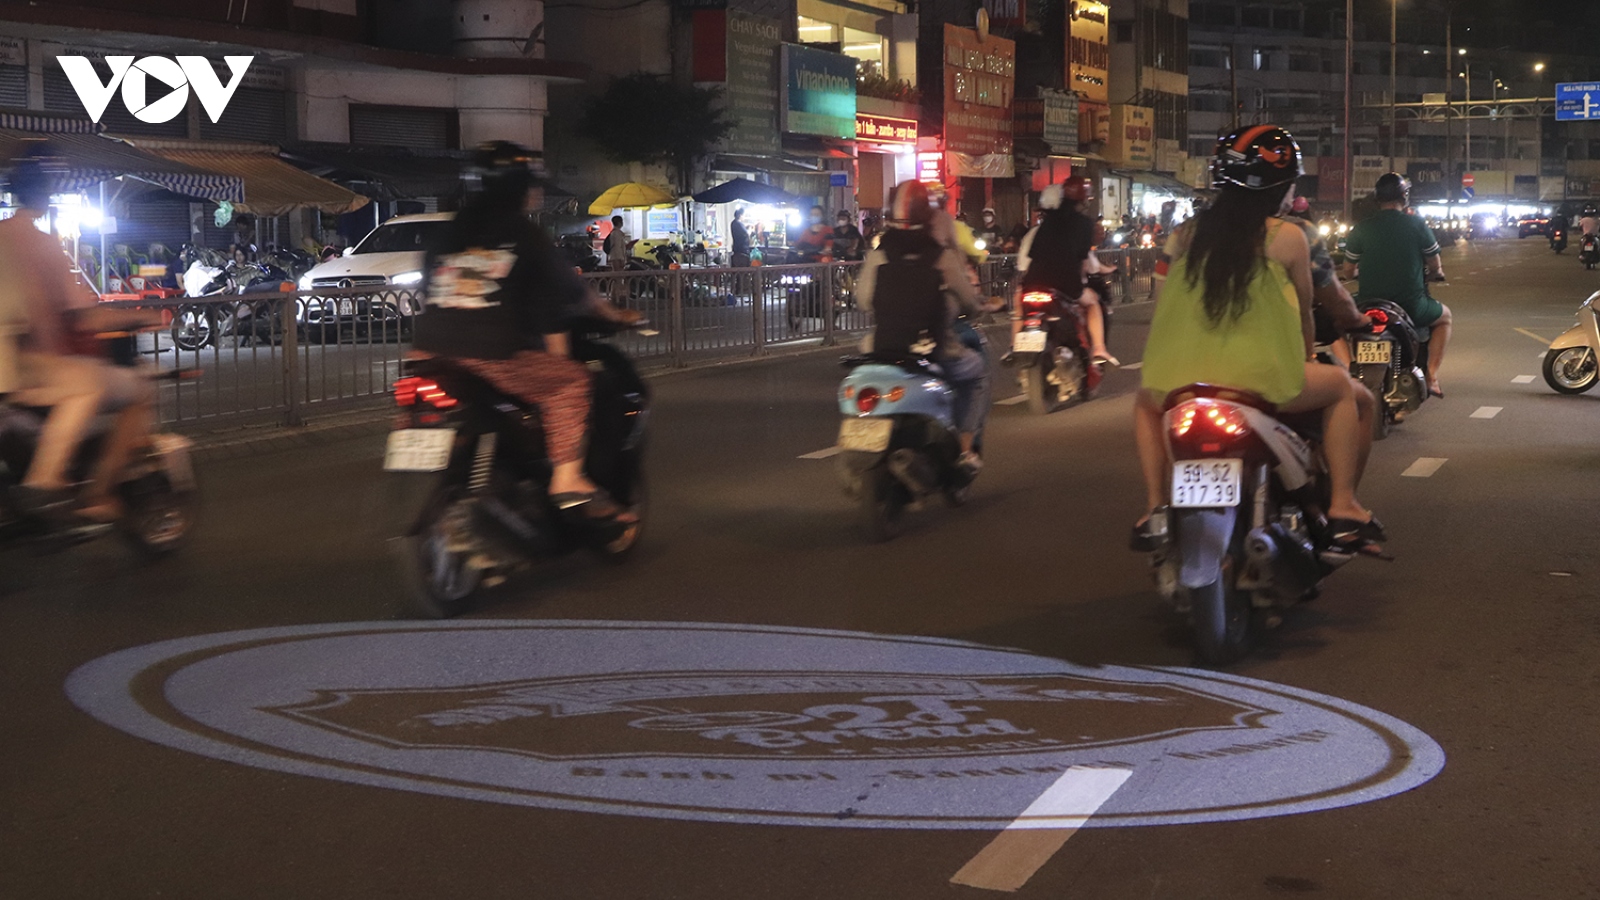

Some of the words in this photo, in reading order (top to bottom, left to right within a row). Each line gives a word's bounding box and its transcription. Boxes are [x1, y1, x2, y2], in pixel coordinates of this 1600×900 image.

[730, 18, 754, 35] CHAY
[755, 23, 779, 41] SẠCH
[734, 40, 774, 57] Vegetarian
[795, 64, 850, 96] vinaphone
[1358, 352, 1390, 362] 133.19
[1183, 463, 1231, 483] 59-S2
[1176, 484, 1235, 504] 317.39
[700, 718, 1036, 749] Bread
